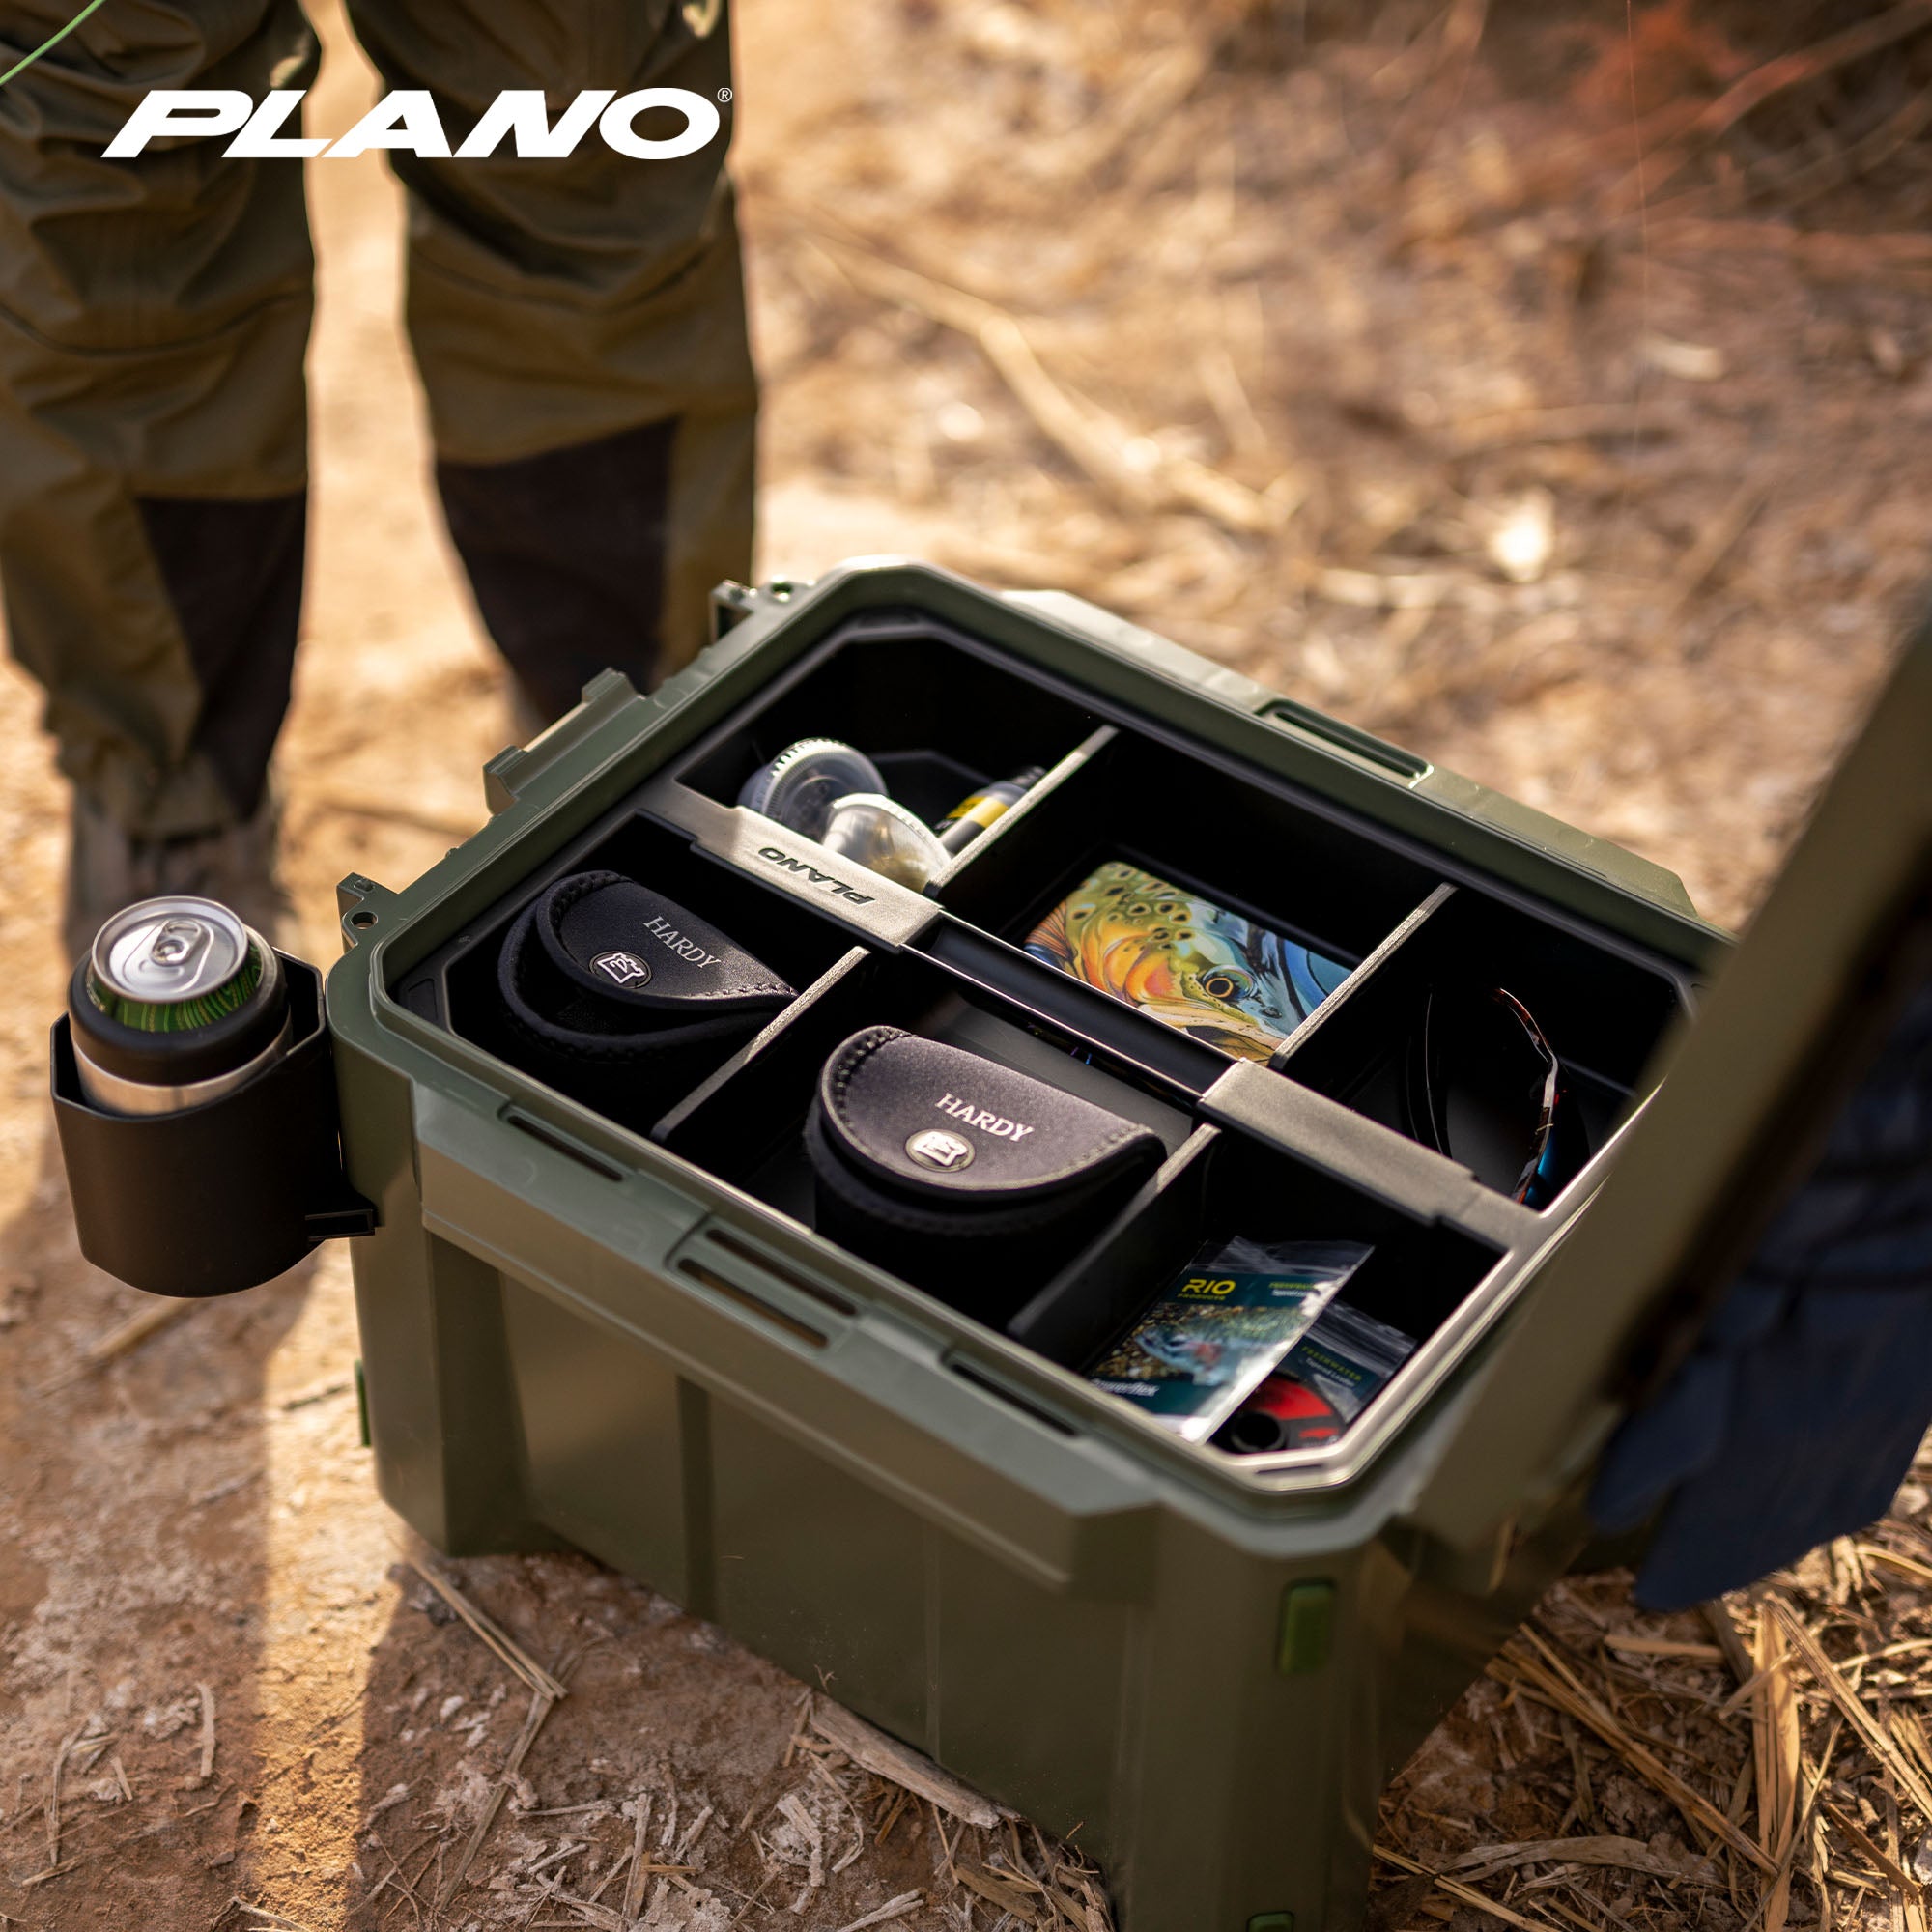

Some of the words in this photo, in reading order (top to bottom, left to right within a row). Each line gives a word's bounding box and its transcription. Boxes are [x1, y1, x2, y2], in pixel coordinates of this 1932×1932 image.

[758, 847, 875, 905] PLANO
[643, 915, 720, 970] HARDY
[935, 1093, 1036, 1144] HARDY
[1181, 1278, 1236, 1295] RIO
